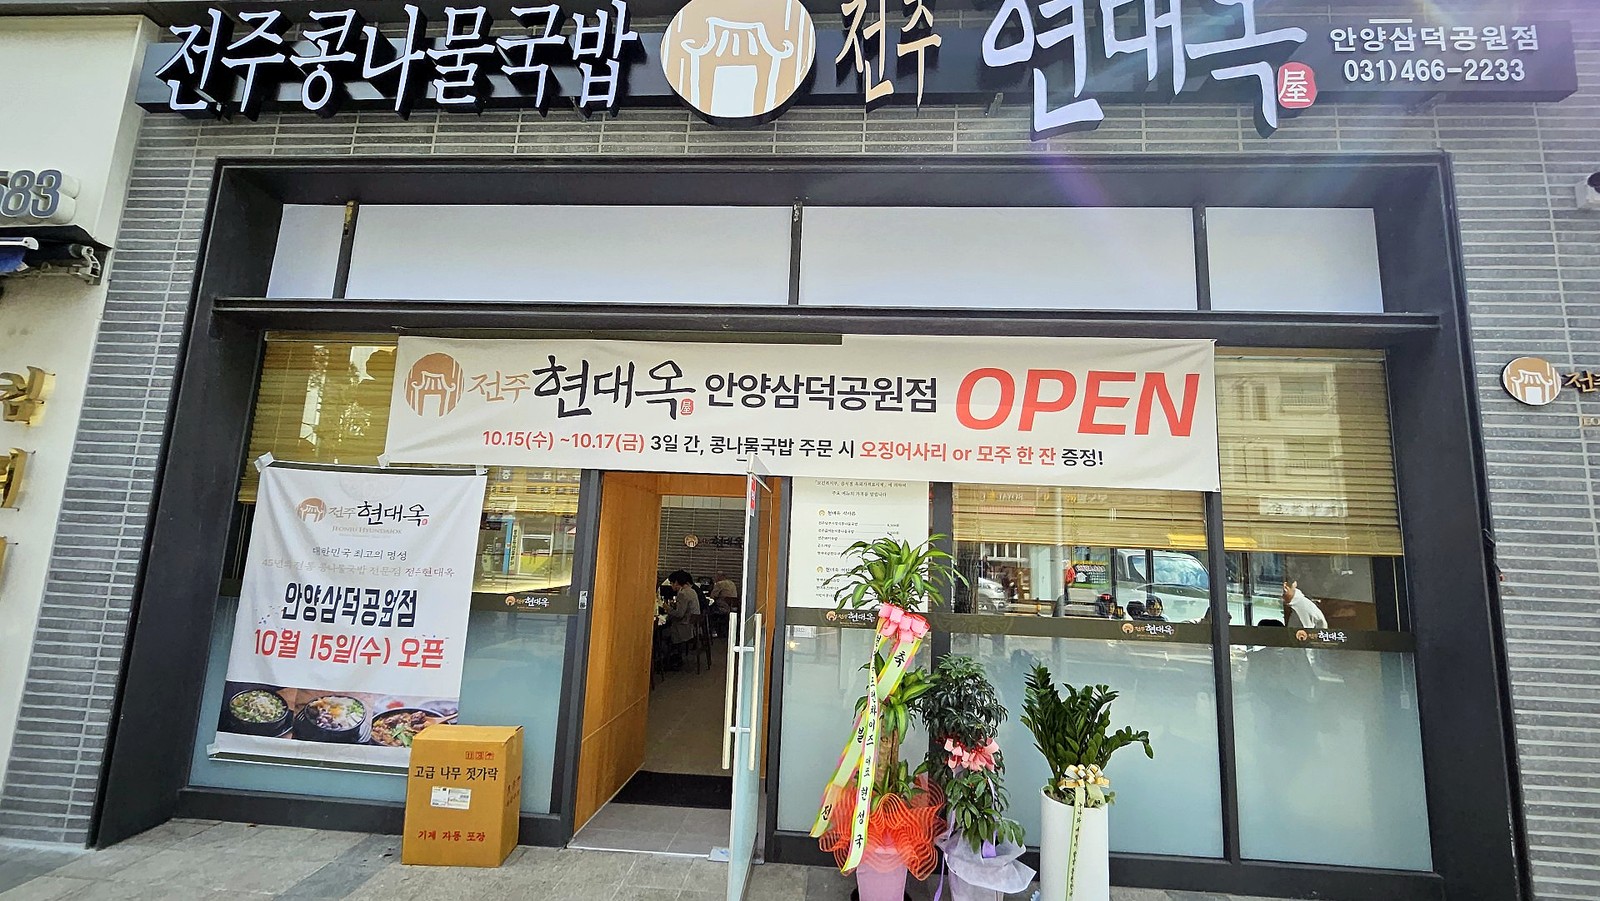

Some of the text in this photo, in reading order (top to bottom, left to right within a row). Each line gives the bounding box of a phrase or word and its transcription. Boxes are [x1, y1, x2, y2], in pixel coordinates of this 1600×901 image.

[155, 0, 638, 111] 전주콩나물국밥
[1329, 25, 1540, 52] 안양삼덕공원점
[1278, 67, 1312, 104] 屋
[1343, 58, 1526, 83] 031)466-2233
[467, 370, 532, 404] 전주
[532, 355, 697, 420] 현대옥
[704, 371, 938, 413] 안양삼덕공원점
[955, 366, 1201, 437] OPEN
[481, 430, 1105, 467] 10.15(수) ~10.17(금) 3일 간, 콩나물국밥 주문 시 오징어사리 or 모주 한 잔 증정!
[328, 505, 357, 519] 전주
[356, 500, 430, 528] 현대옥
[312, 546, 408, 562] 대한민국 최고의 명성
[281, 582, 418, 628] 안양삼덕공원점
[255, 629, 445, 669] 10월 15일(수) 오픈
[414, 765, 499, 781] 고급 나무 젓가락
